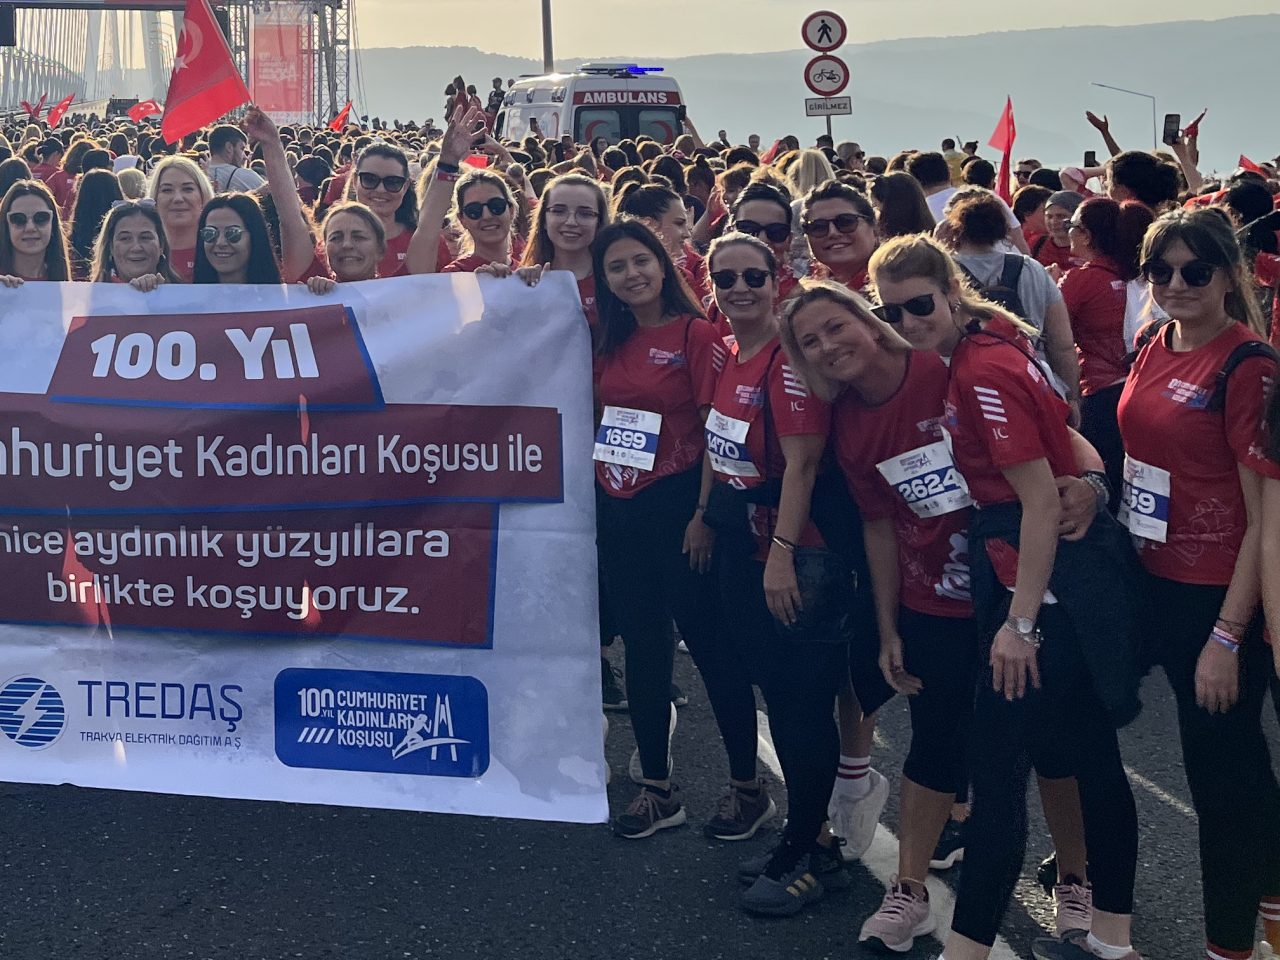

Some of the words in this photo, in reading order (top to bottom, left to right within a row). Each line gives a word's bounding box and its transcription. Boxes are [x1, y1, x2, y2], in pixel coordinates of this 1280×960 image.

[582, 92, 668, 104] AMBULANS
[91, 331, 216, 380] 100.
[225, 323, 319, 379] Yıl
[605, 428, 647, 450] 1699
[707, 433, 740, 460] 1470
[198, 432, 365, 476] Kadınları
[378, 434, 499, 484] Koşusu
[508, 433, 542, 472] ile
[898, 468, 962, 501] 2624
[75, 526, 224, 566] aydınlık
[237, 523, 450, 568] yüzyıllara
[47, 572, 175, 607] birlikte
[186, 576, 420, 620] koşuyoruz.
[78, 681, 244, 732] TREDAŞ
[337, 690, 428, 711] CUMHURİYET
[80, 732, 122, 742] TRAKYA
[125, 733, 176, 745] ELEKTRİK
[179, 734, 222, 747] DAĞITIM
[337, 728, 394, 748] KOŞUSU
